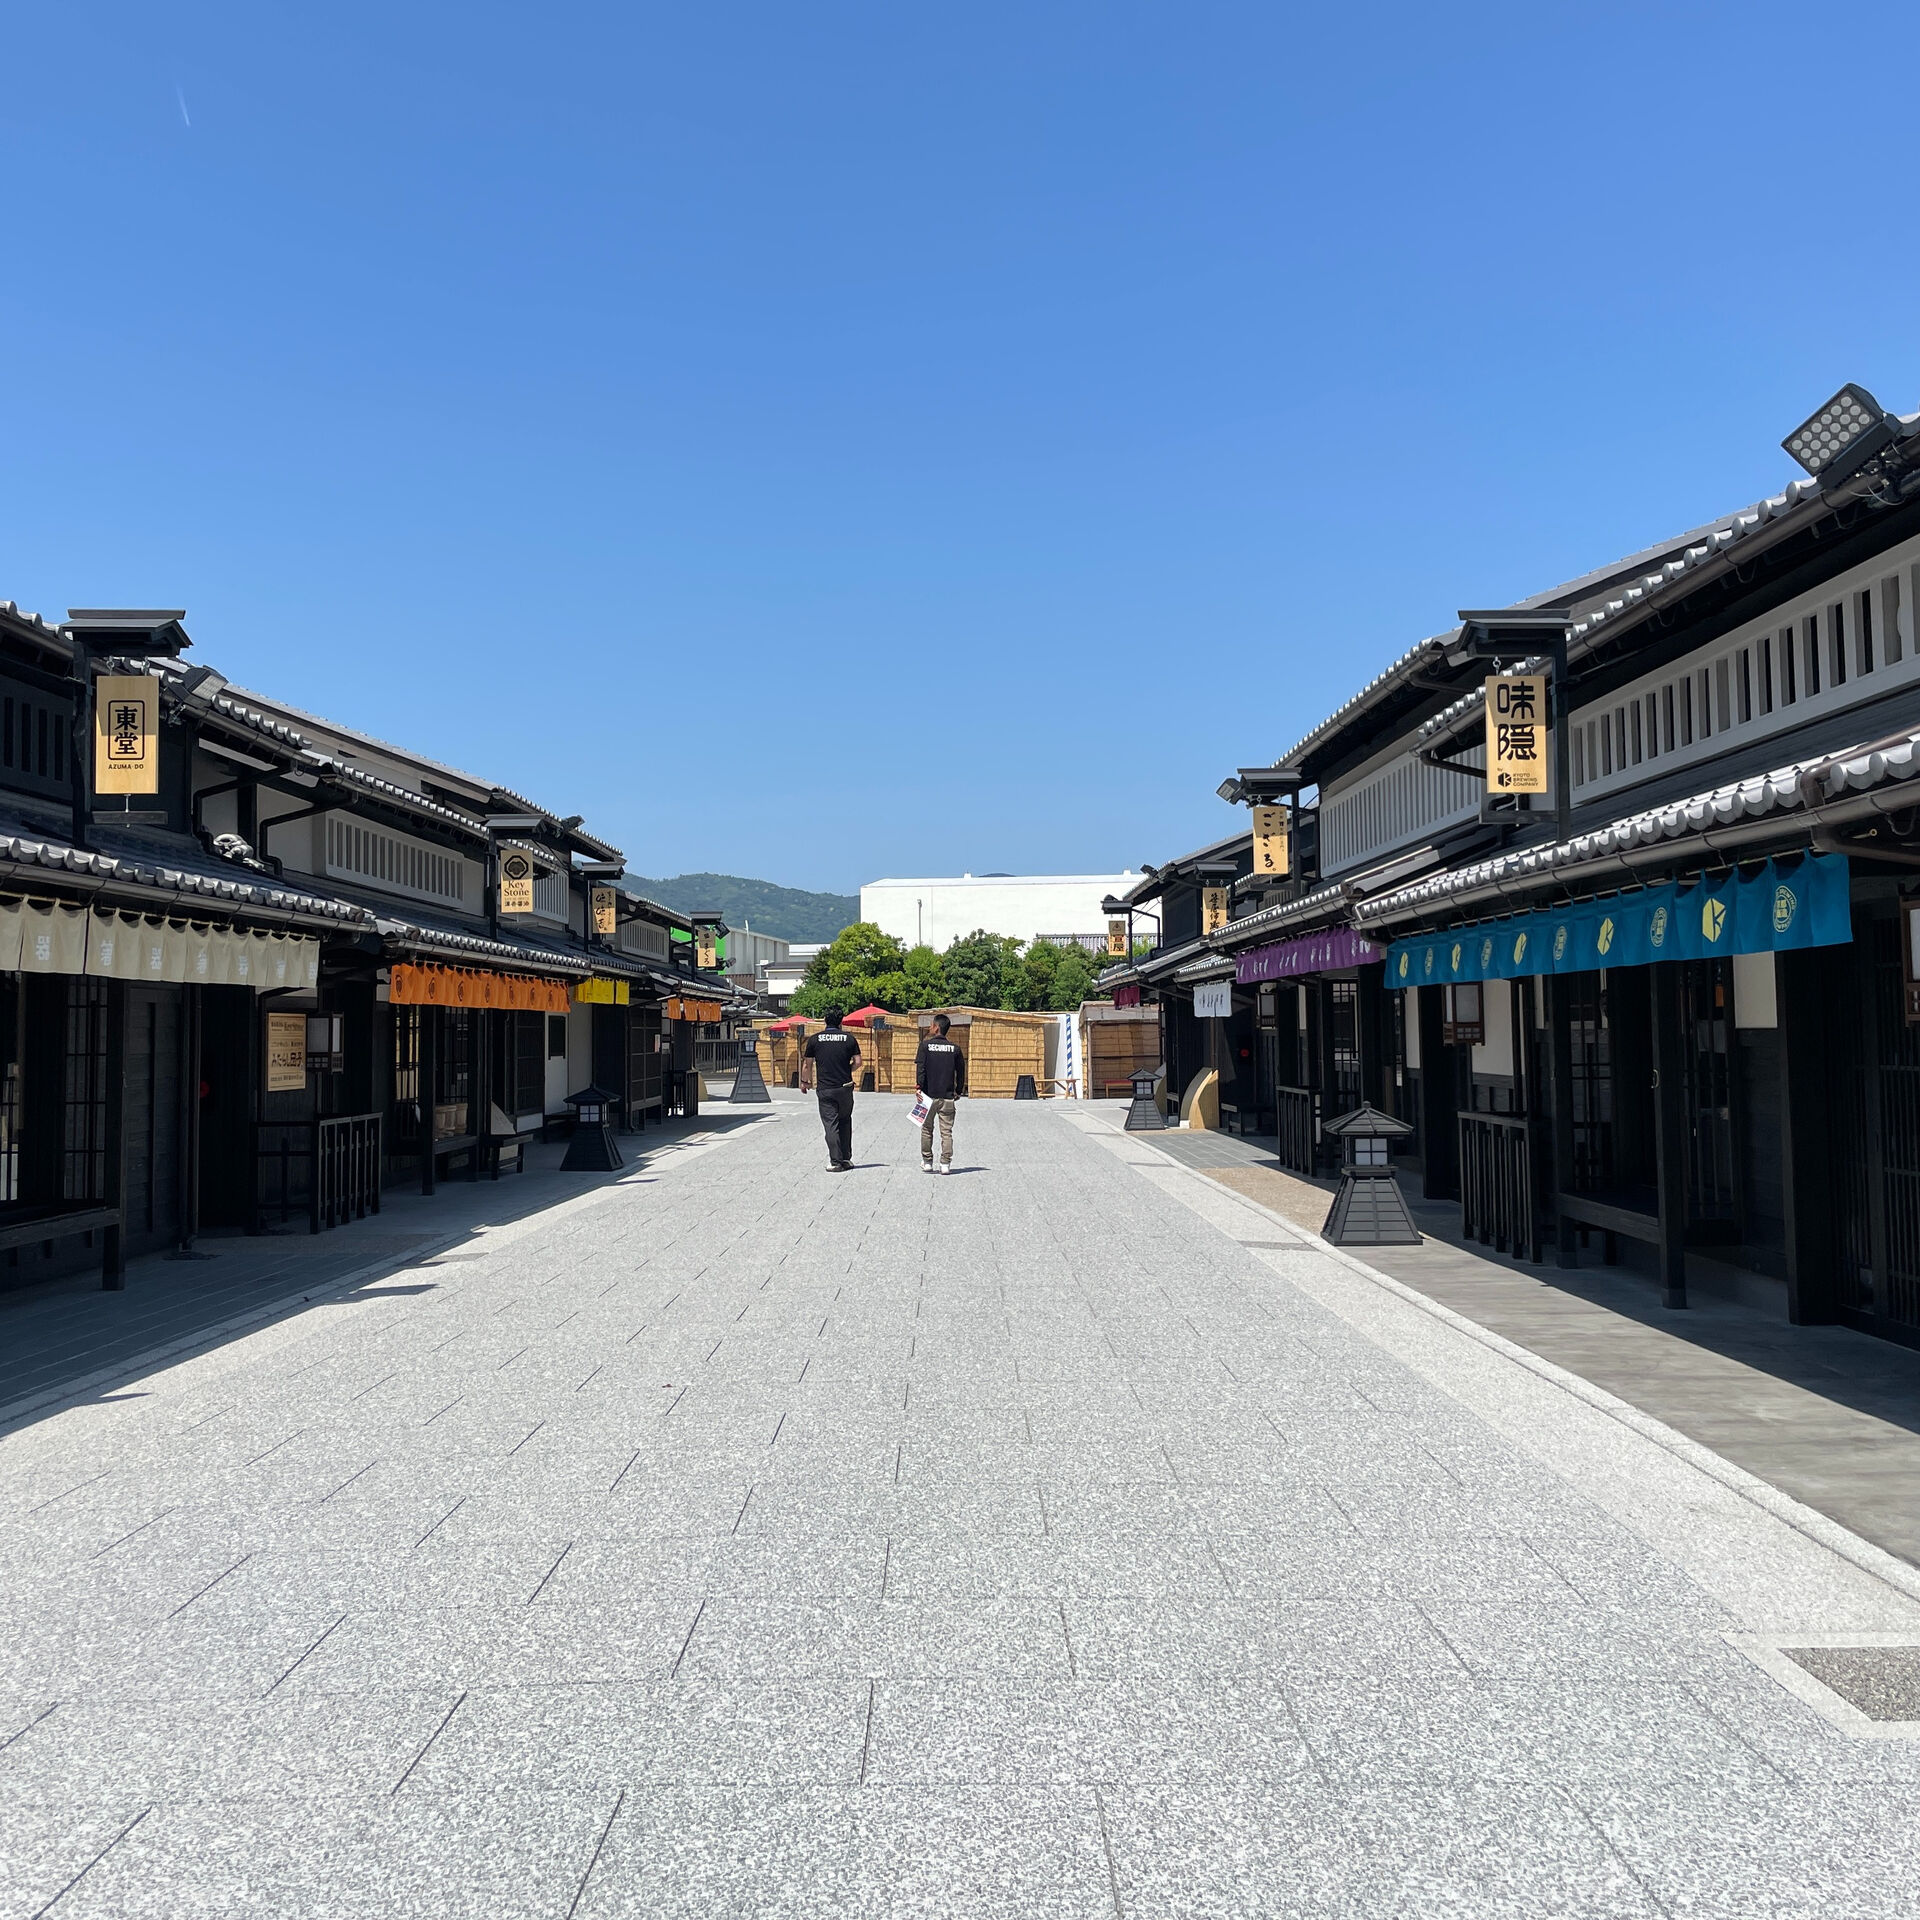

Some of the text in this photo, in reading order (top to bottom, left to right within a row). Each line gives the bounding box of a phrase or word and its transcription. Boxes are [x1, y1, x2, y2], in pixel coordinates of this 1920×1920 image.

[1497, 681, 1537, 760] 味隠
[114, 706, 138, 754] 東堂
[508, 880, 525, 890] Key
[504, 888, 530, 896] Stone
[818, 1034, 848, 1042] SECURITY
[928, 1044, 955, 1053] SECURITY
